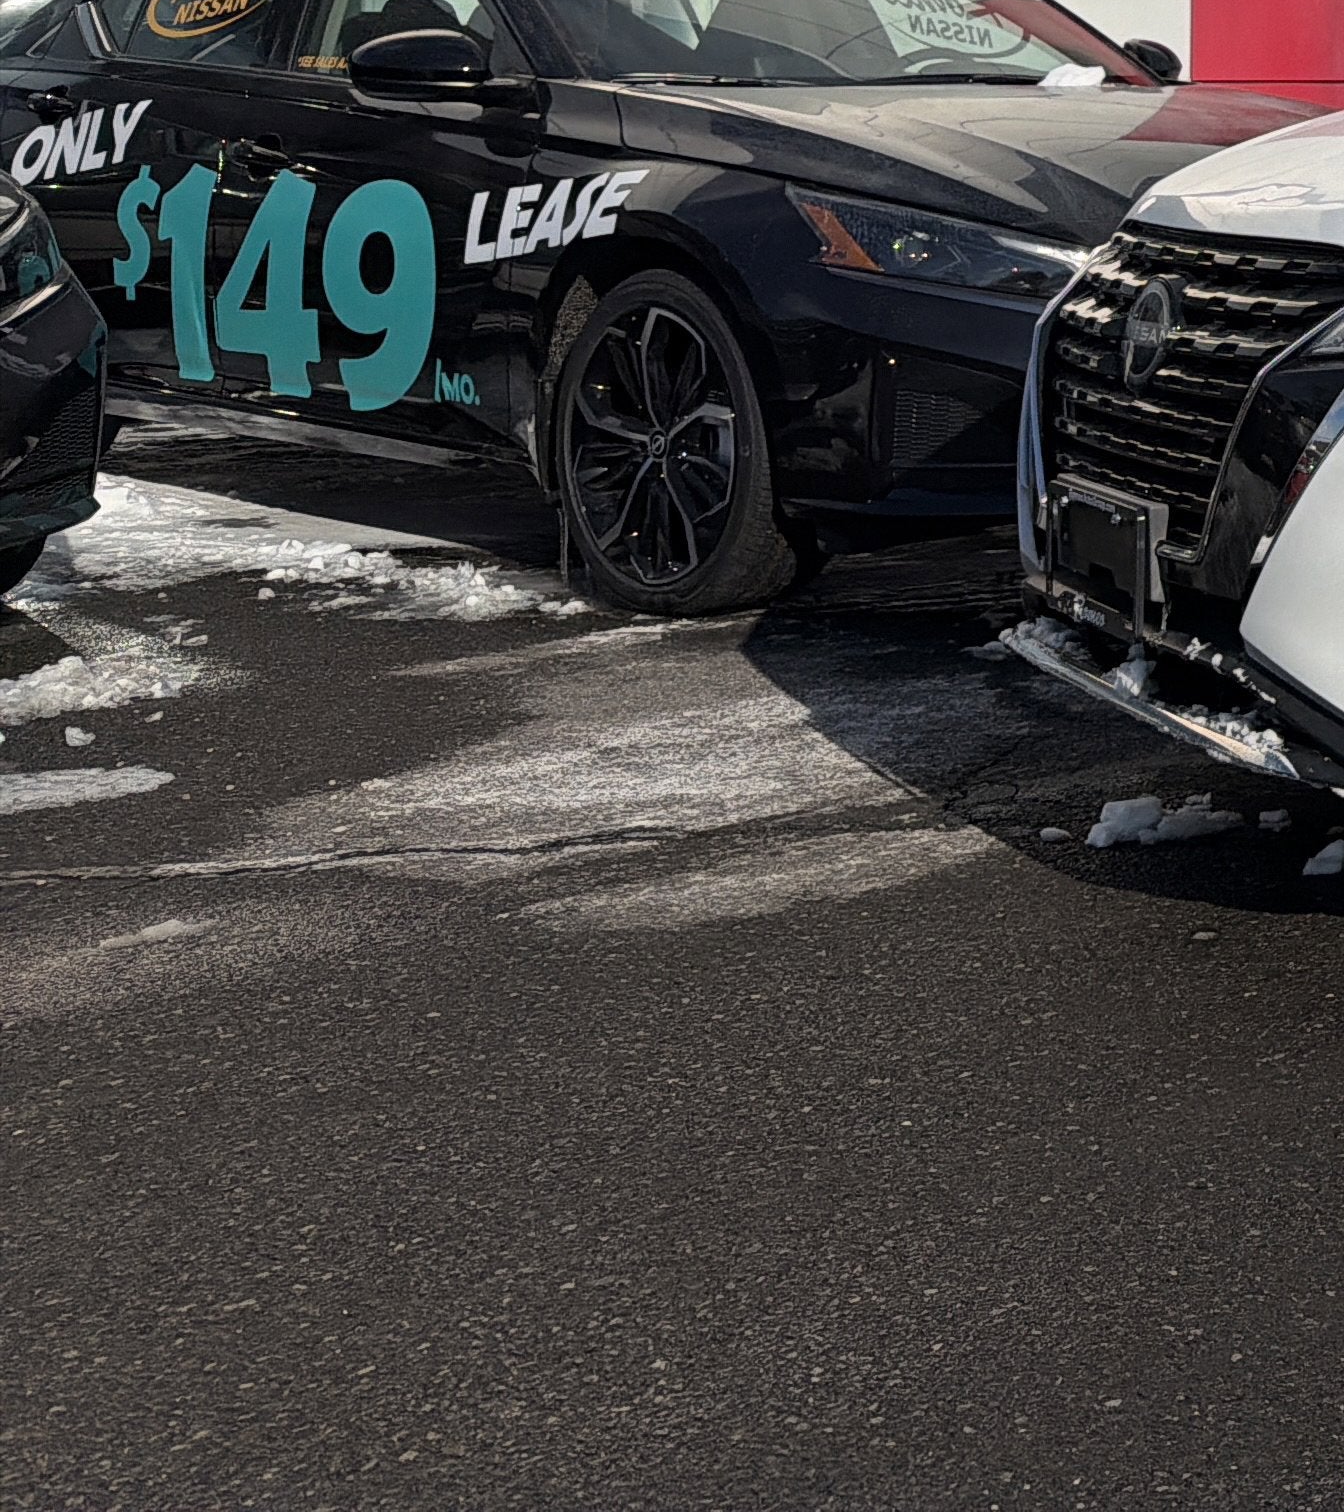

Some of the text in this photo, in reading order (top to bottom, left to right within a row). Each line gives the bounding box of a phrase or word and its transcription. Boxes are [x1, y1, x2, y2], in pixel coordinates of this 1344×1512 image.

[11, 99, 152, 186] ONLY
[463, 169, 650, 264] LEASE
[113, 163, 480, 411] $149 /MO.
